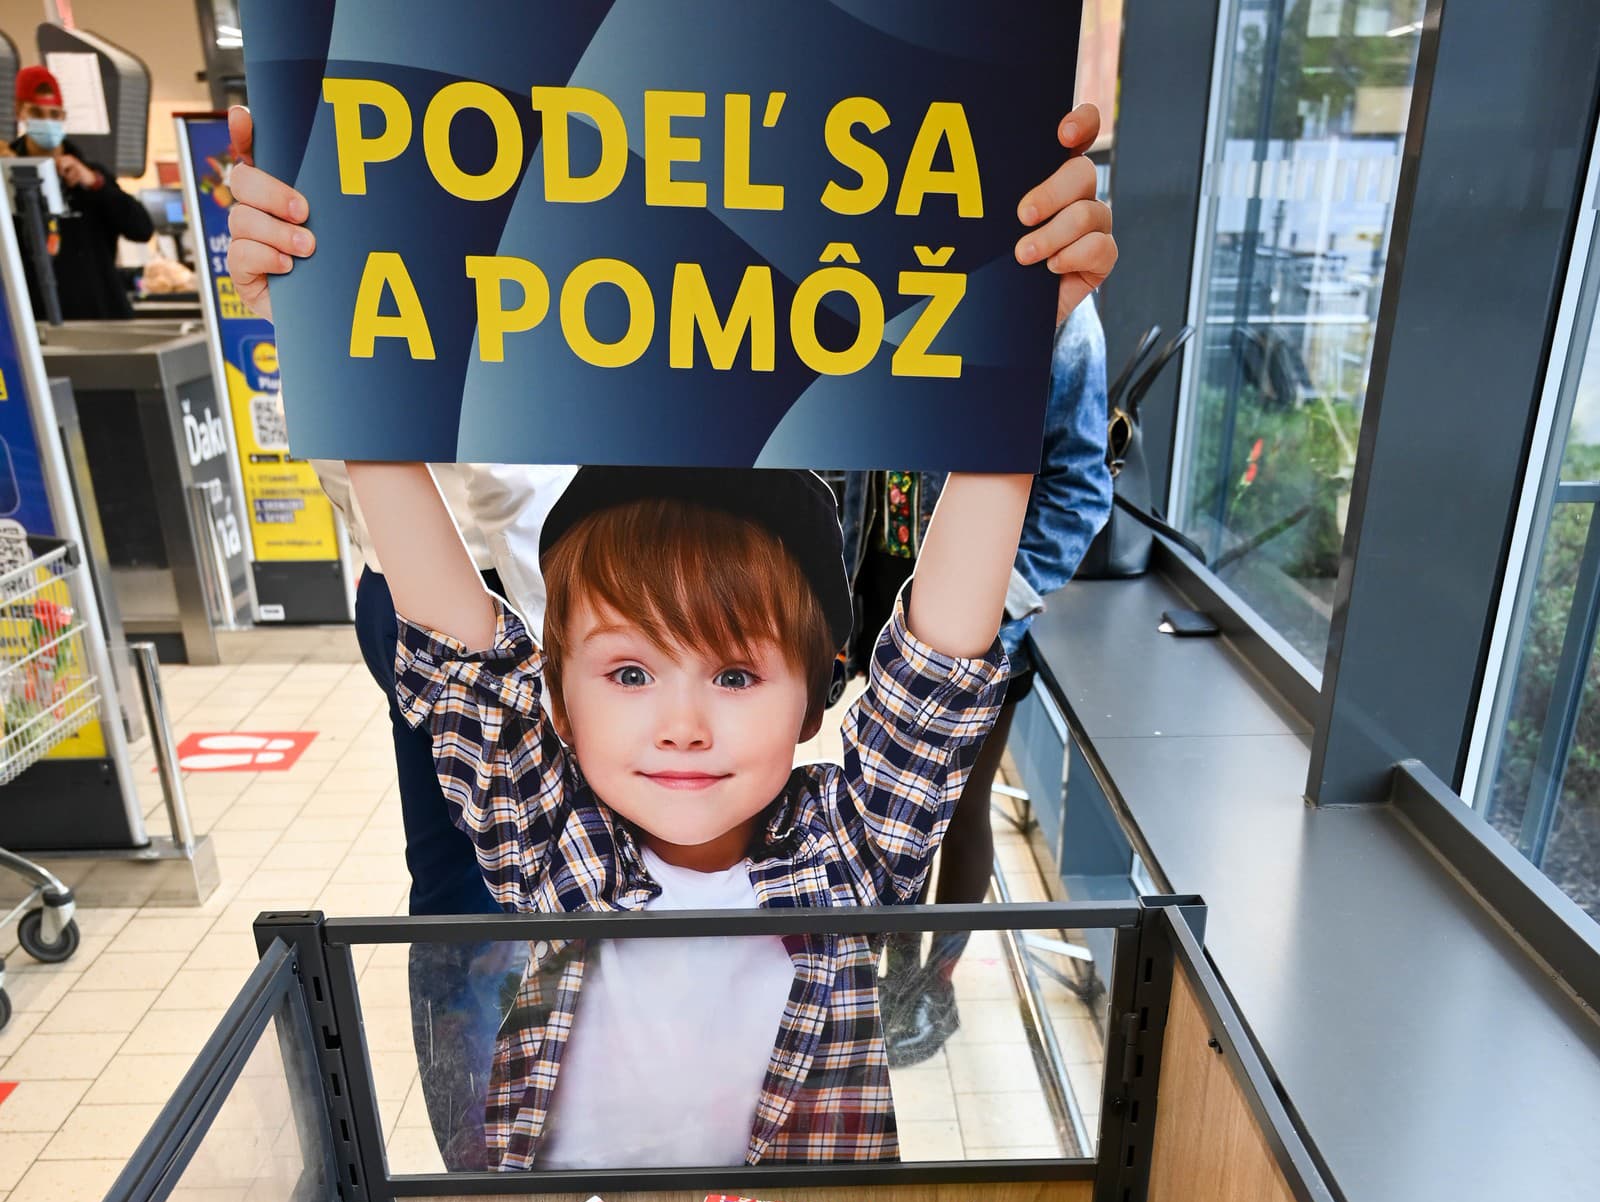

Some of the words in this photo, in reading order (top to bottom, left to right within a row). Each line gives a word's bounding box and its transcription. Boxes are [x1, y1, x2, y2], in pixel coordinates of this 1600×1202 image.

[323, 77, 787, 212] PODEĽ
[820, 96, 985, 219] SA
[349, 252, 436, 361] A
[465, 243, 968, 379] POMÔŽ
